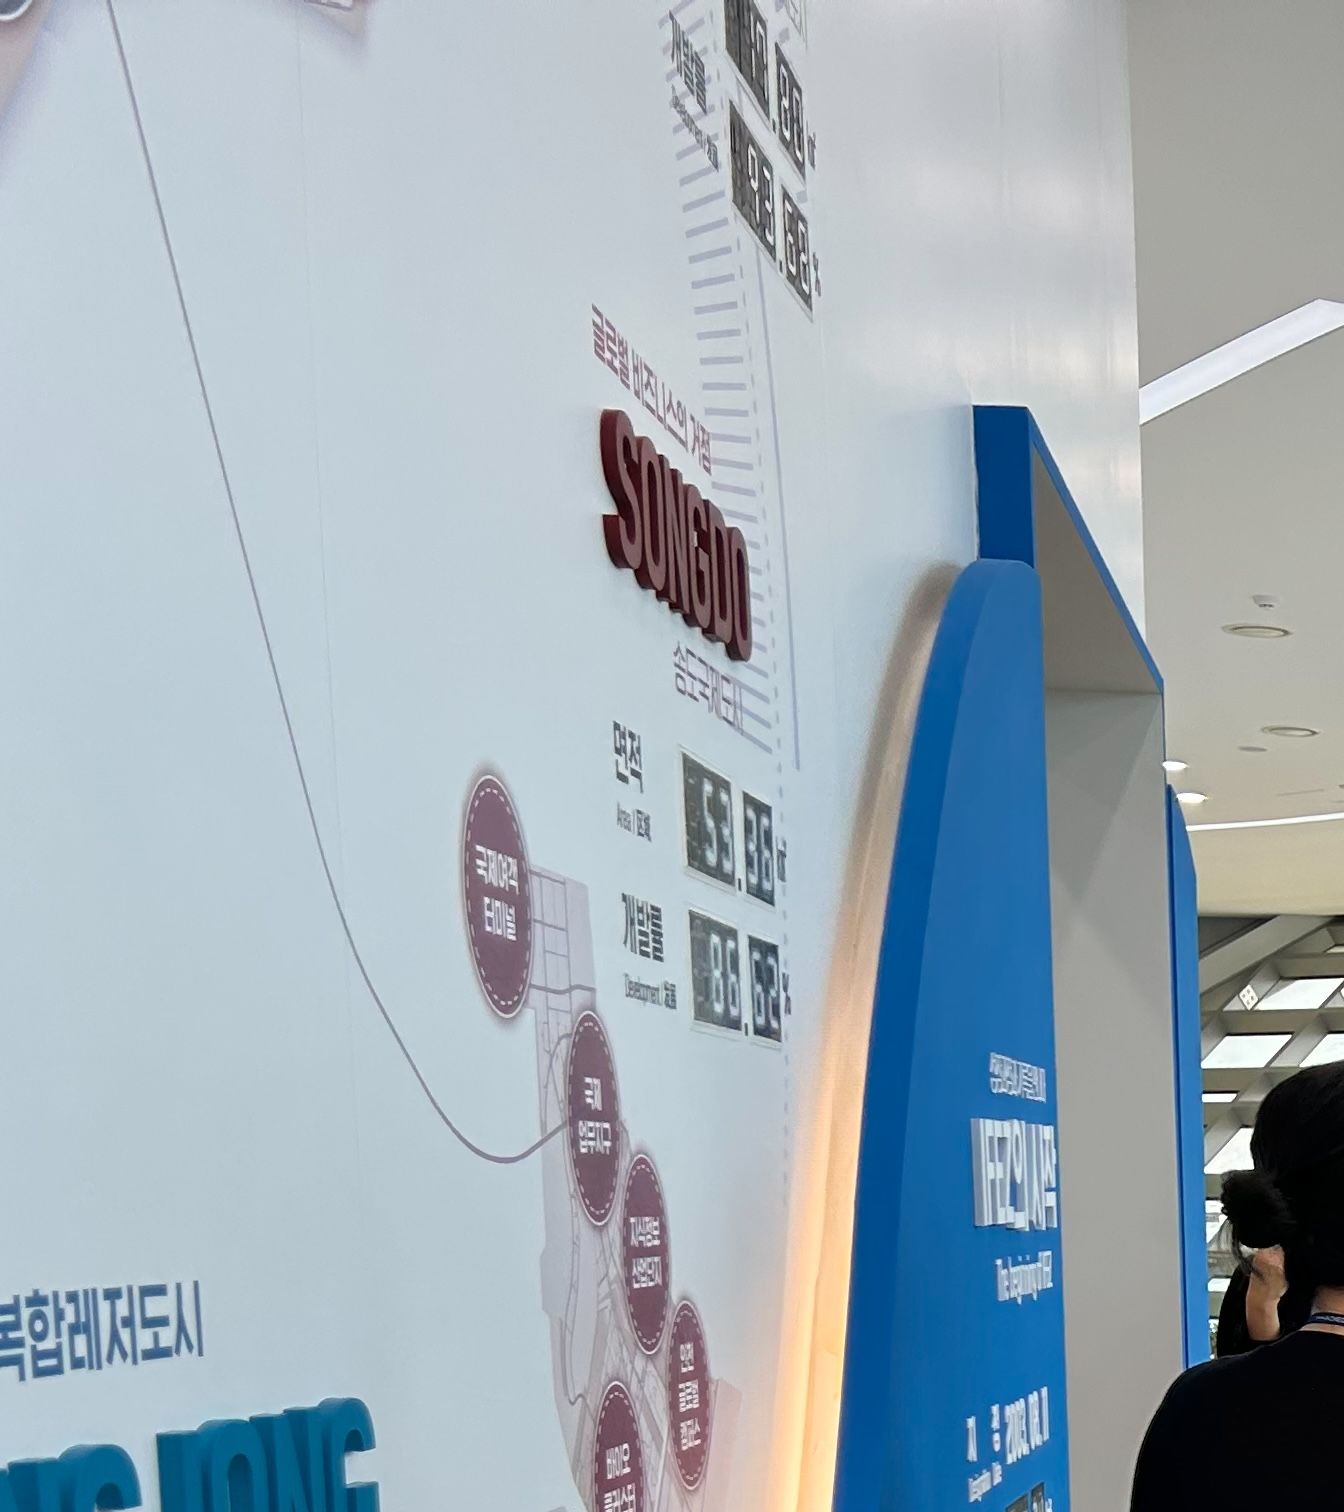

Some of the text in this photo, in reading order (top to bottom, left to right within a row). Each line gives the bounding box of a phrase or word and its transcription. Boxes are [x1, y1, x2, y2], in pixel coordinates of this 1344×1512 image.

[591, 303, 712, 477] 글로벌 비즈니스의 거점
[600, 408, 753, 662] SONGDO
[673, 640, 744, 735] 송도국제도시
[613, 720, 644, 794] 면적
[475, 845, 520, 895] 국제여객
[483, 896, 517, 942] 터미널
[0, 1280, 205, 1382] 복합레저도시
[606, 1442, 632, 1480] 바이오
